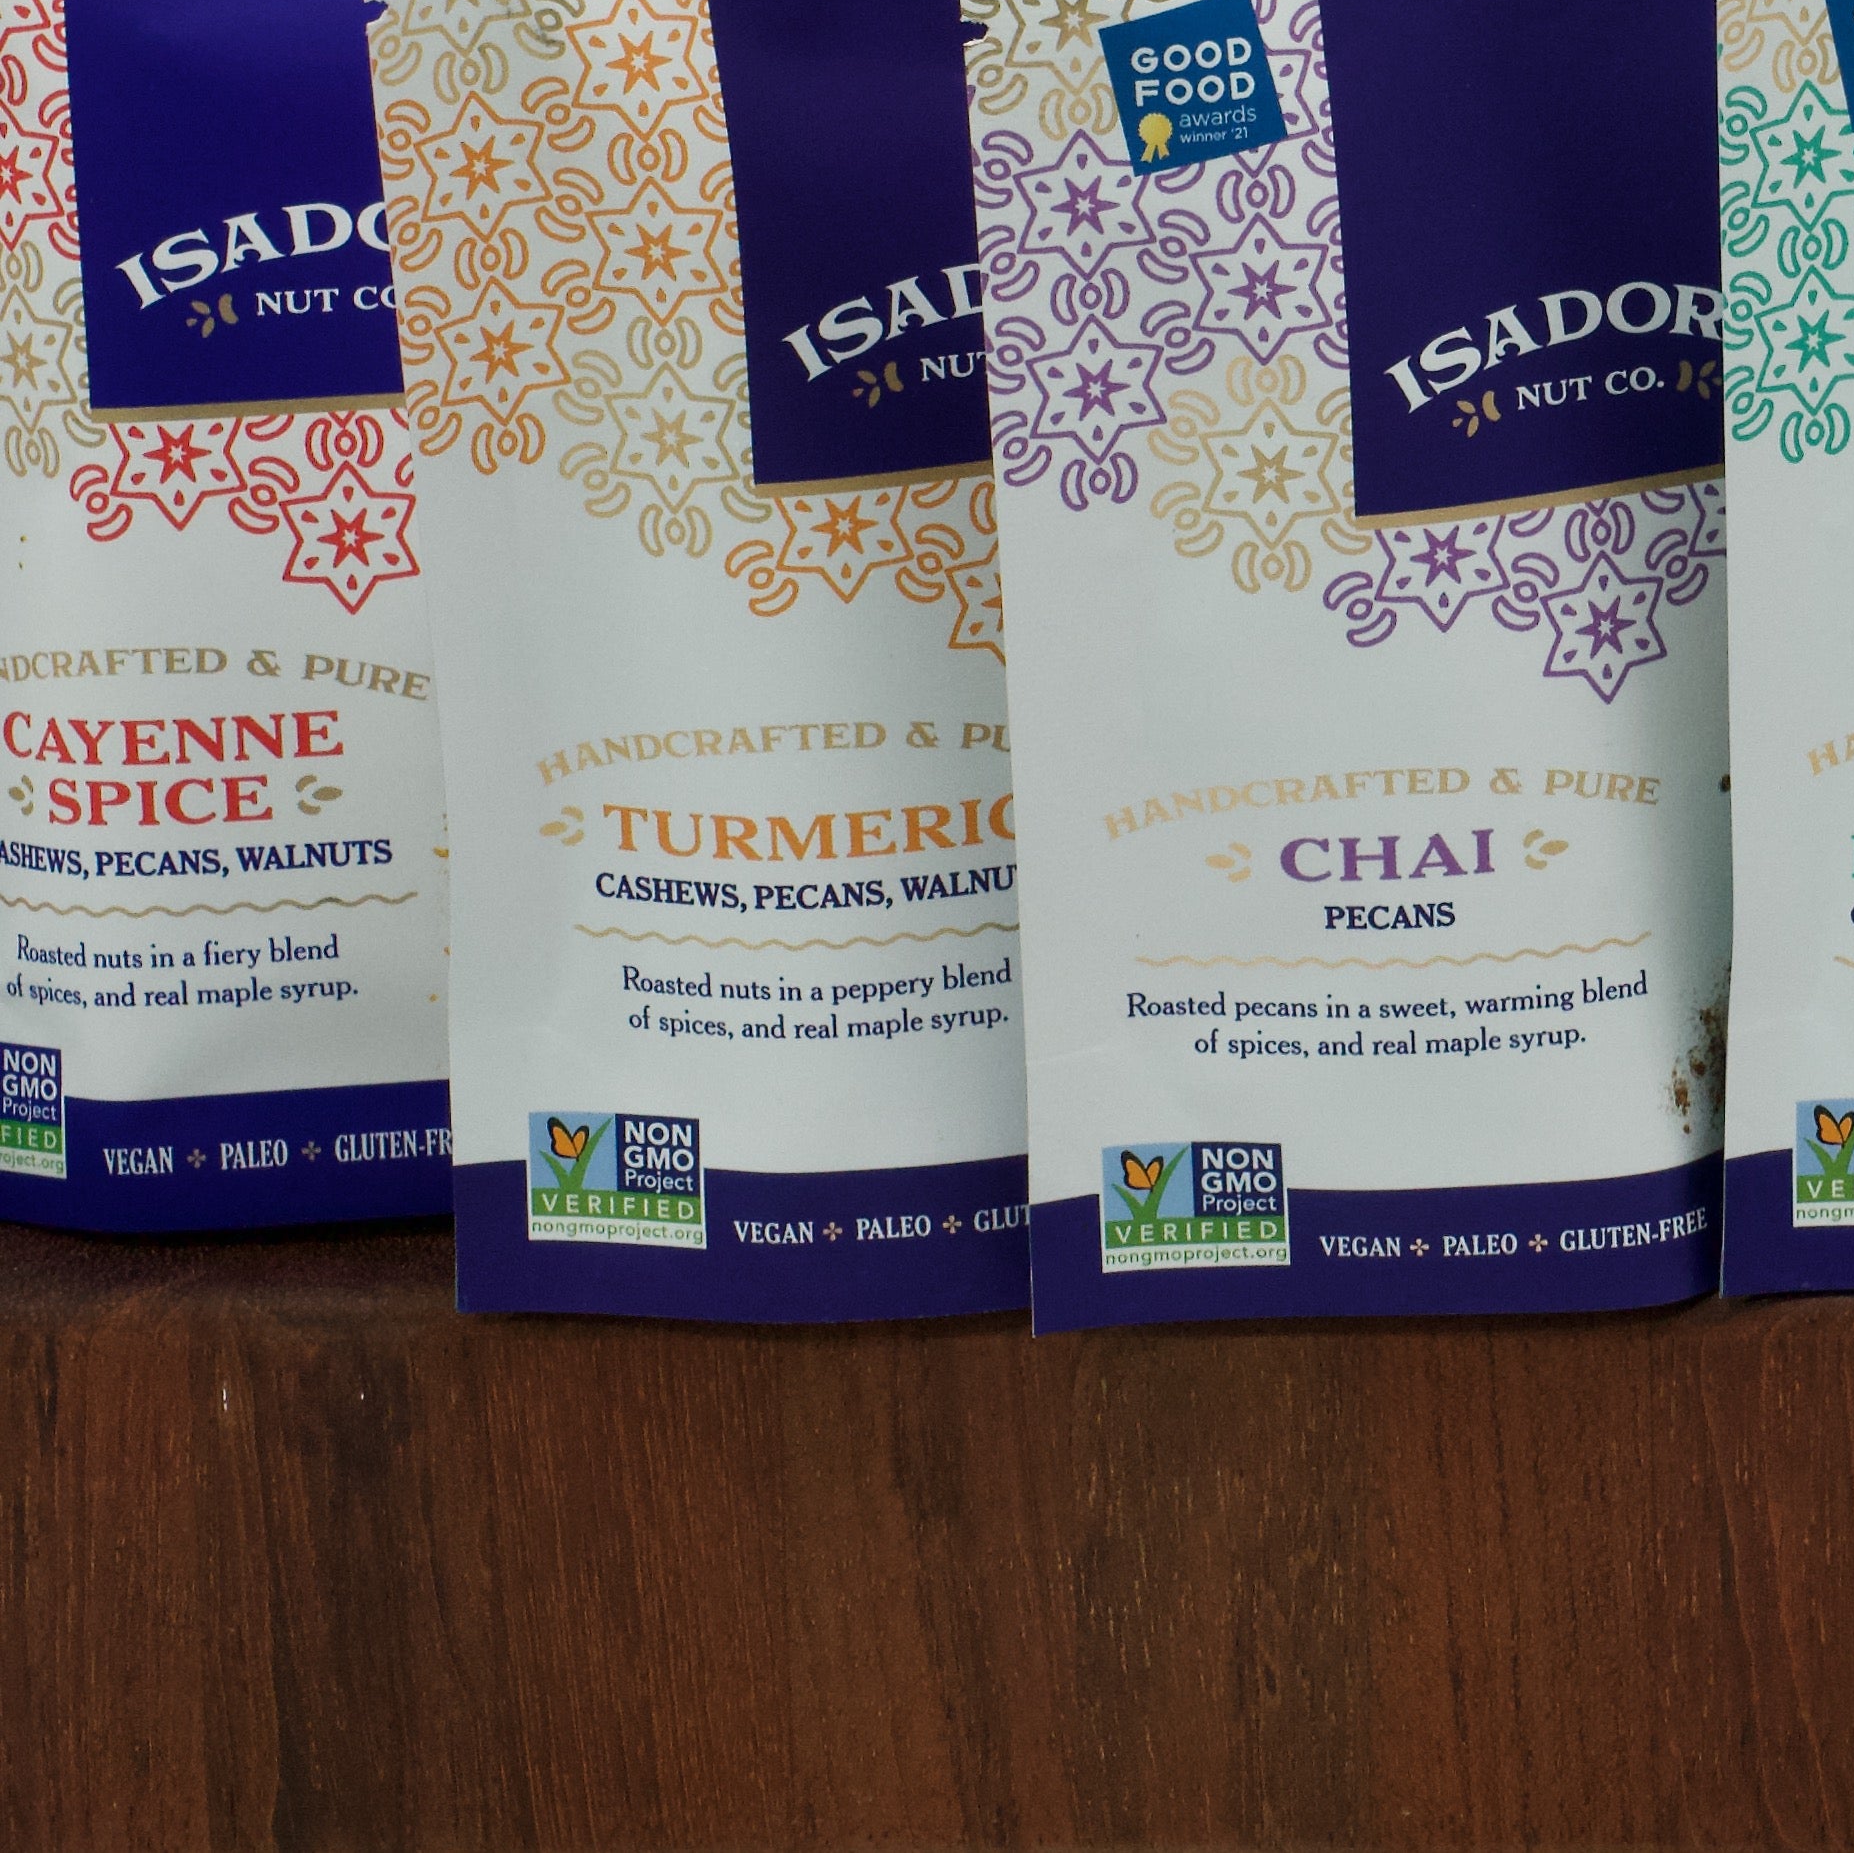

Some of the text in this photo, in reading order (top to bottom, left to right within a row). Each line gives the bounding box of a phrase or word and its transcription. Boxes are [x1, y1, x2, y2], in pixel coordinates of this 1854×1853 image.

[1132, 37, 1251, 73] GOOD
[1135, 72, 1255, 106] FOOD
[1180, 105, 1256, 127] awards
[1181, 132, 1227, 144] winner
[256, 289, 339, 315] NUT
[1516, 367, 1664, 410] NUT CO.
[247, 650, 430, 701] & PURE
[3, 711, 343, 765] CAYENNE
[536, 720, 938, 786] HANDCRAFTED &
[49, 775, 272, 825] SPICE
[1104, 768, 1661, 841] HANDCRAFTED & PURE
[95, 849, 229, 877] PECANS,
[236, 839, 392, 871] WALNUTS
[1280, 829, 1495, 882] CHAI
[596, 873, 893, 913] CASHEWS, PECANS,
[1324, 902, 1455, 930] PECANS
[18, 934, 339, 969] Roasted nuts in a fiery blend
[623, 958, 1012, 1005] Roasted nuts in a peppery blend
[1127, 970, 1648, 1021] Roasted pecans in a sweet, warming blend
[1195, 1026, 1585, 1061] of spices, and real maple syrup.
[3, 1049, 56, 1076] NON
[2, 1074, 58, 1101] GMO
[2, 1096, 56, 1122] Project
[624, 1121, 692, 1147] NON
[104, 1147, 172, 1174] VEGAN
[221, 1140, 287, 1169] PALEO
[624, 1146, 695, 1171] GMO
[1202, 1147, 1275, 1170] NON
[625, 1169, 693, 1191] Project
[1201, 1171, 1276, 1194] GMO
[542, 1193, 694, 1220] VERIFIED
[1203, 1194, 1276, 1216] Project
[531, 1219, 704, 1244] nongmoproject.org
[734, 1216, 930, 1243] VEGAN PALEO
[1116, 1219, 1279, 1244] VERIFIED
[1320, 1208, 1708, 1256] VEGAN PALEO GLUTEN-FREE
[1106, 1247, 1286, 1266] nongmoproject.org
